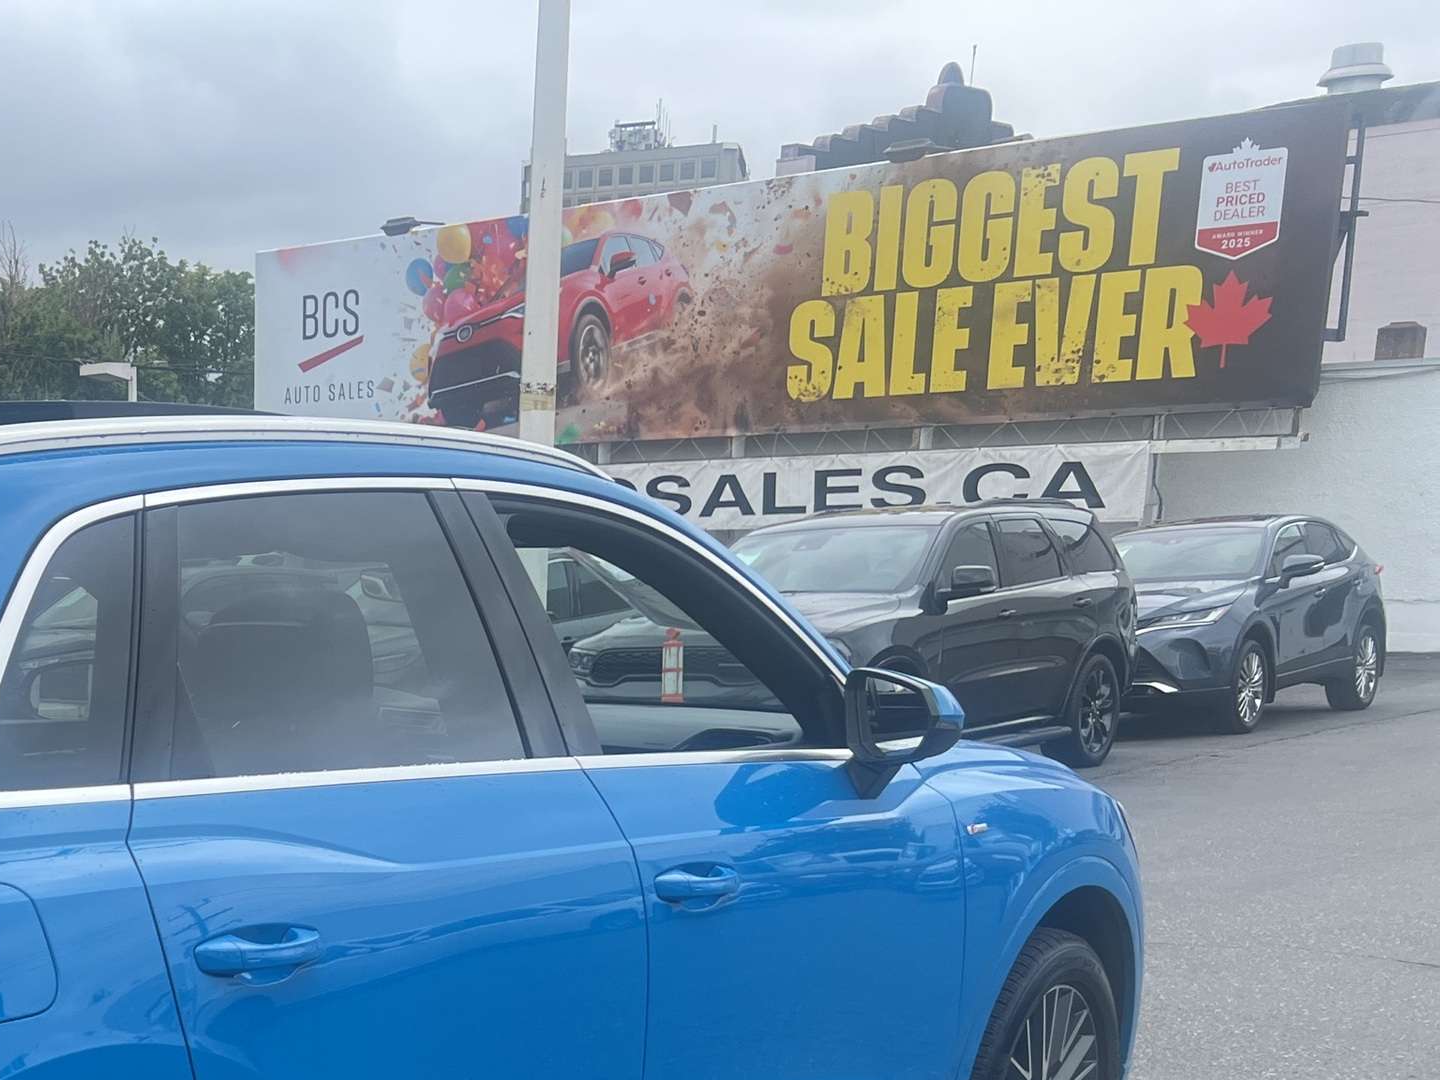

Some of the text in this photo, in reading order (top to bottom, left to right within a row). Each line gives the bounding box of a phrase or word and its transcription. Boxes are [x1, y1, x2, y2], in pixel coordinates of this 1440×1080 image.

[1215, 156, 1283, 171] AutoTrader
[1225, 180, 1260, 194] BEST
[1216, 192, 1265, 207] PRICED
[1214, 205, 1265, 221] DEALER
[821, 147, 1180, 296] BIGGEST
[1221, 237, 1251, 249] 2025
[302, 289, 359, 340] BCS
[786, 265, 1203, 402] SALE EVER
[284, 380, 375, 404] AUTO SALES
